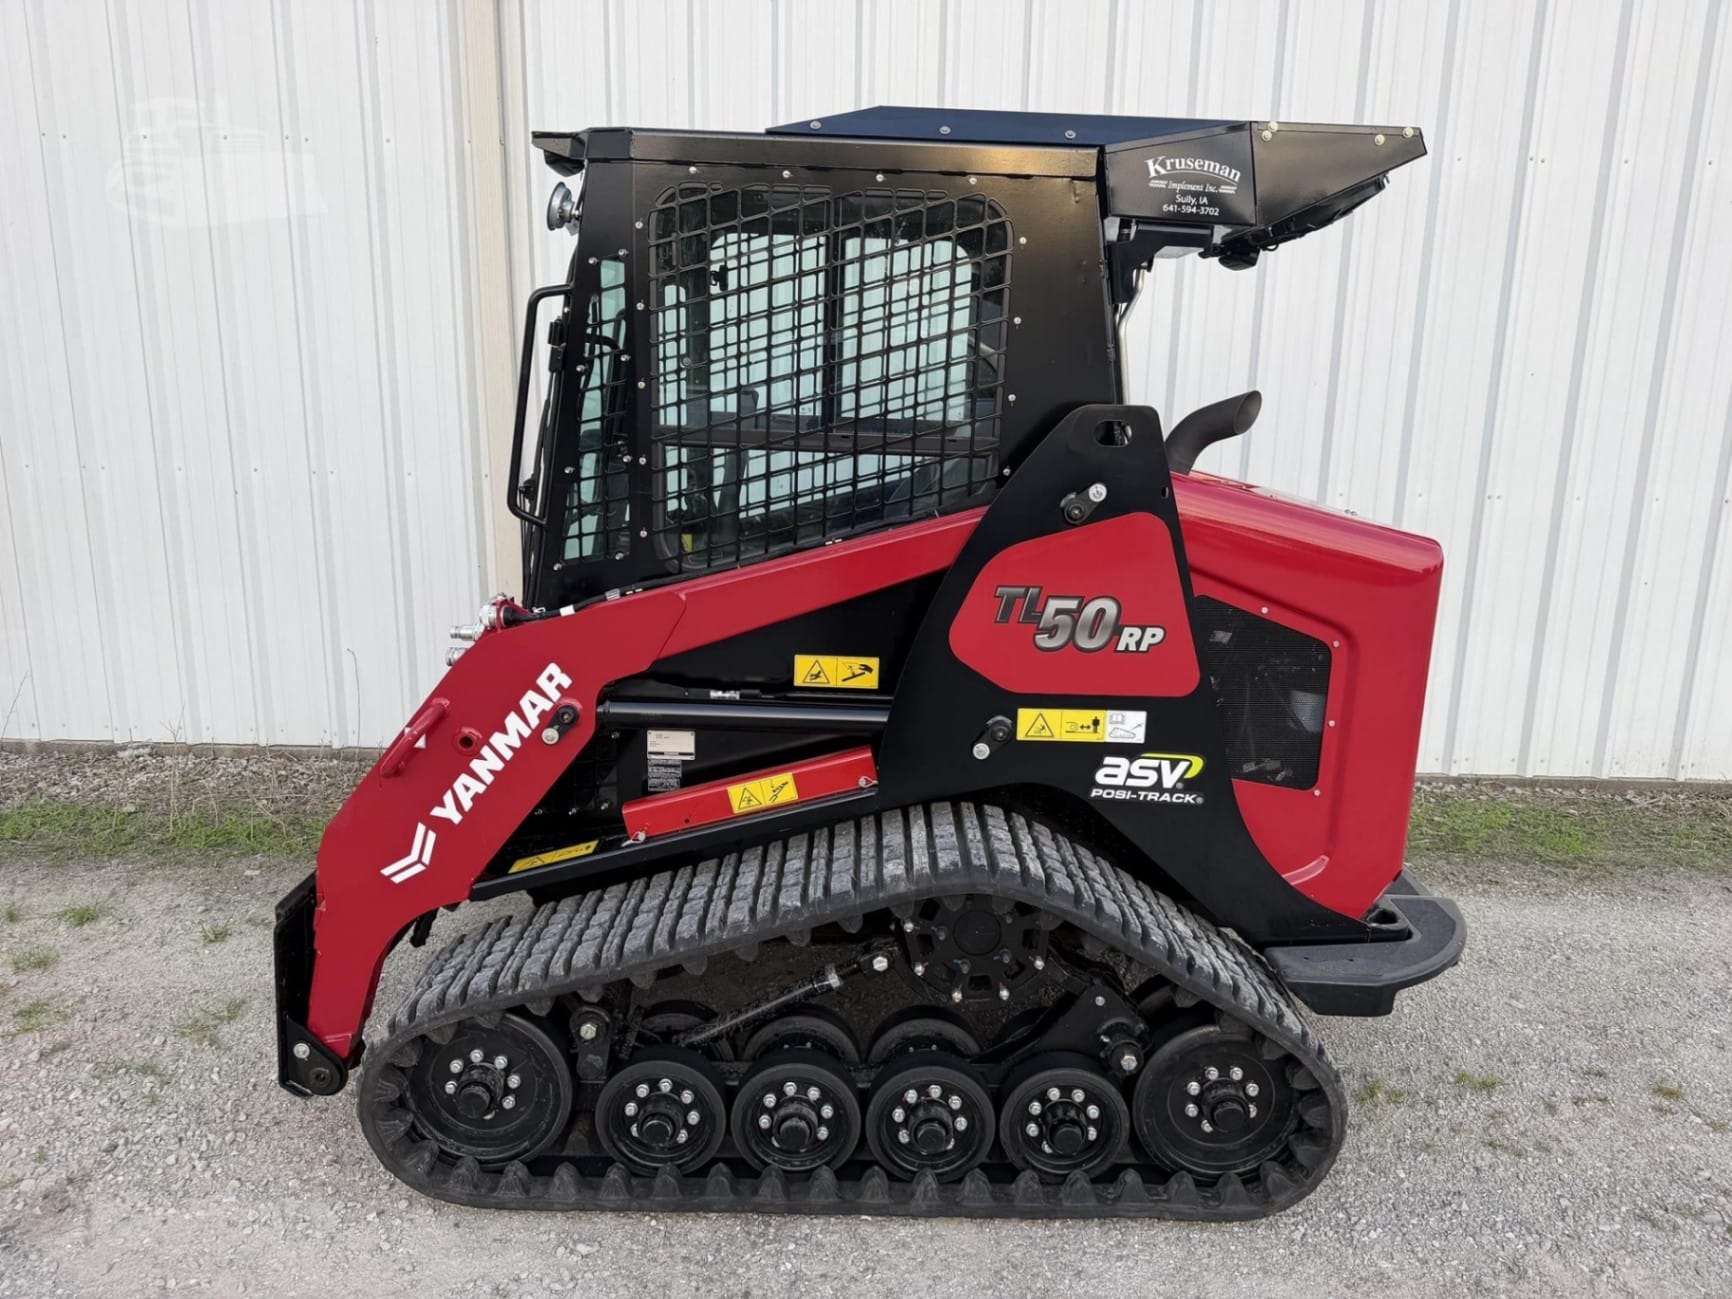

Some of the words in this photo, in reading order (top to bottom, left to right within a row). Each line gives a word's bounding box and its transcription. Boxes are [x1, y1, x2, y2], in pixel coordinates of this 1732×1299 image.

[1145, 156, 1240, 182] Kruseman
[1205, 184, 1218, 193] Inc.
[1175, 195, 1197, 205] Sully,
[1199, 196, 1208, 205] IA
[1163, 204, 1219, 215] 641-594-3702
[430, 662, 573, 825] YANMAR
